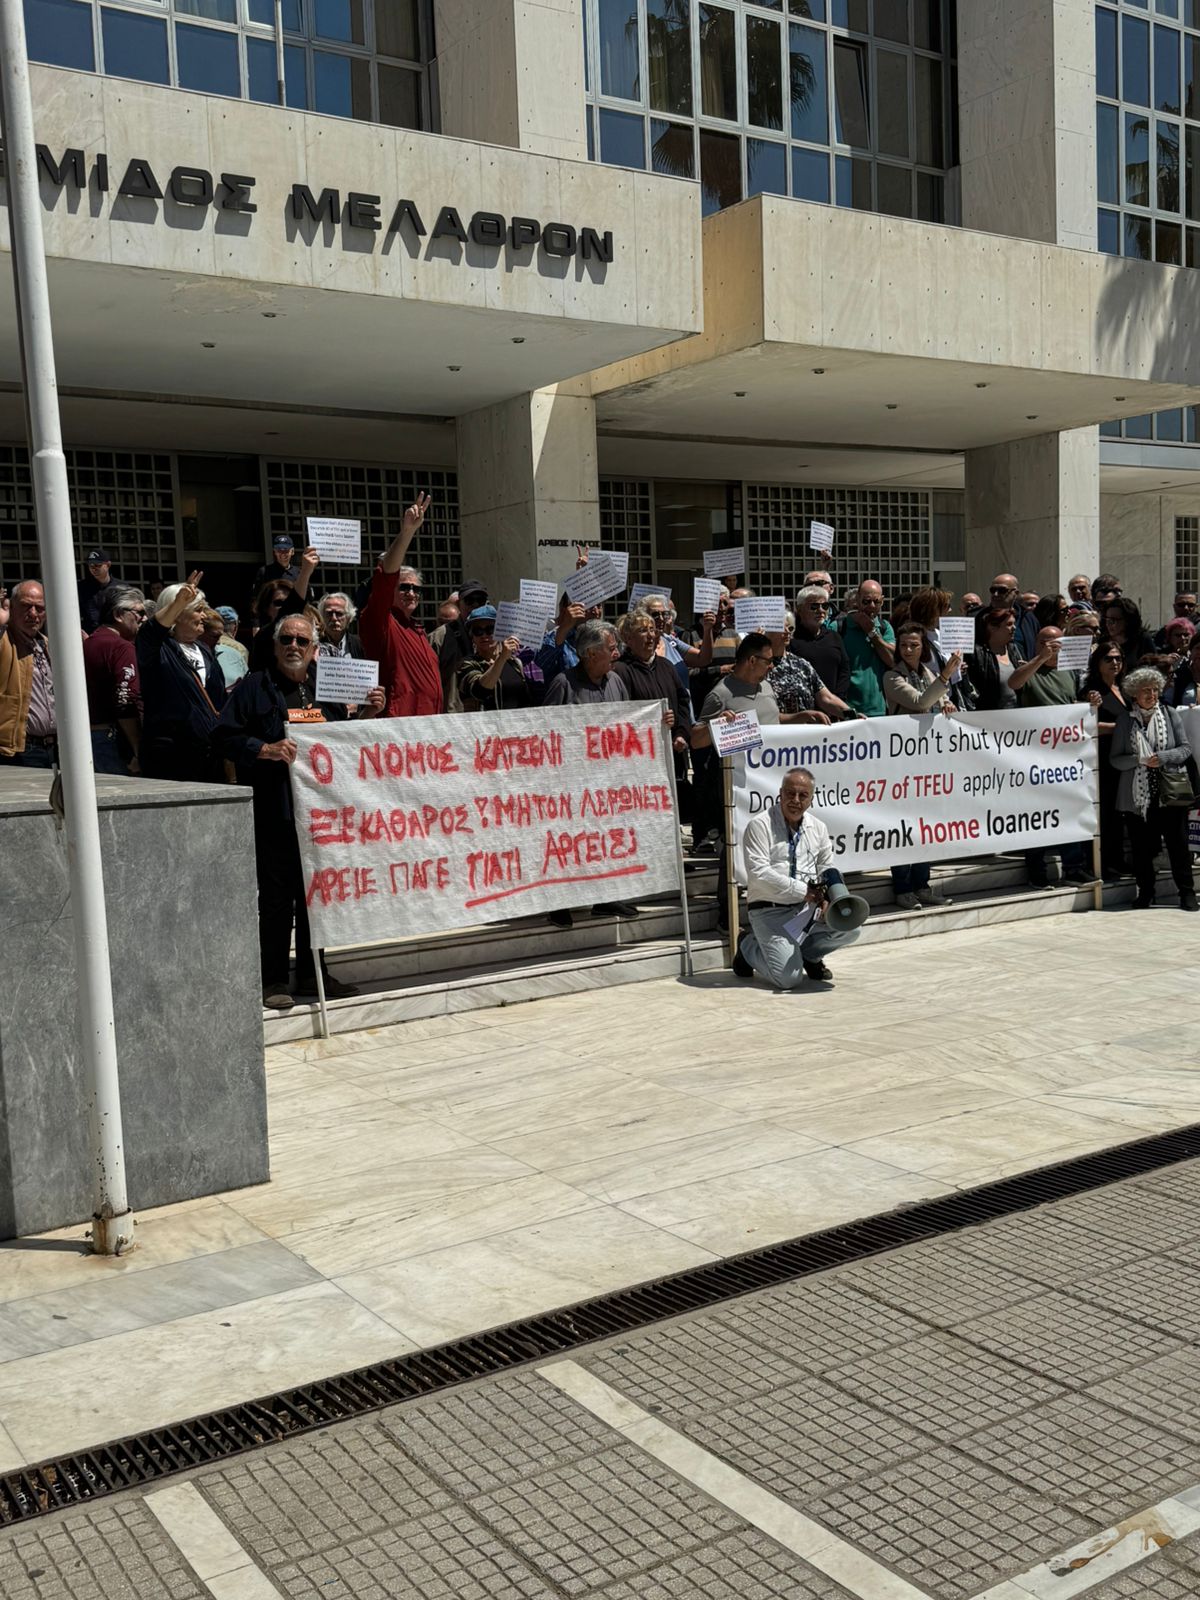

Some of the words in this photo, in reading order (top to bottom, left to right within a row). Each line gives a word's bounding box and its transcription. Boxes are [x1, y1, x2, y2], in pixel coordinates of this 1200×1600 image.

[0, 138, 257, 213] ΜΙΔΟΣ
[292, 183, 613, 263] ΜΕΛΑΘΡΟΝ
[309, 742, 334, 785] Ο
[358, 741, 460, 780] ΝΟΜΟΣ
[585, 722, 656, 760] ΕΙΝΑΙ
[747, 737, 881, 769] Commission
[890, 728, 943, 757] Don't
[949, 726, 990, 753] shut
[993, 728, 1037, 755] your
[1040, 718, 1086, 750] eyes!
[855, 779, 887, 804] 267
[892, 775, 910, 800] of
[913, 772, 954, 798] TFEU
[963, 767, 1005, 797] apply
[1009, 768, 1025, 788] to
[1029, 758, 1085, 787] Greece?
[854, 818, 914, 853] frank
[919, 816, 980, 846] home
[986, 807, 1060, 837] loaners
[389, 856, 450, 894] ΠΑΓΕ
